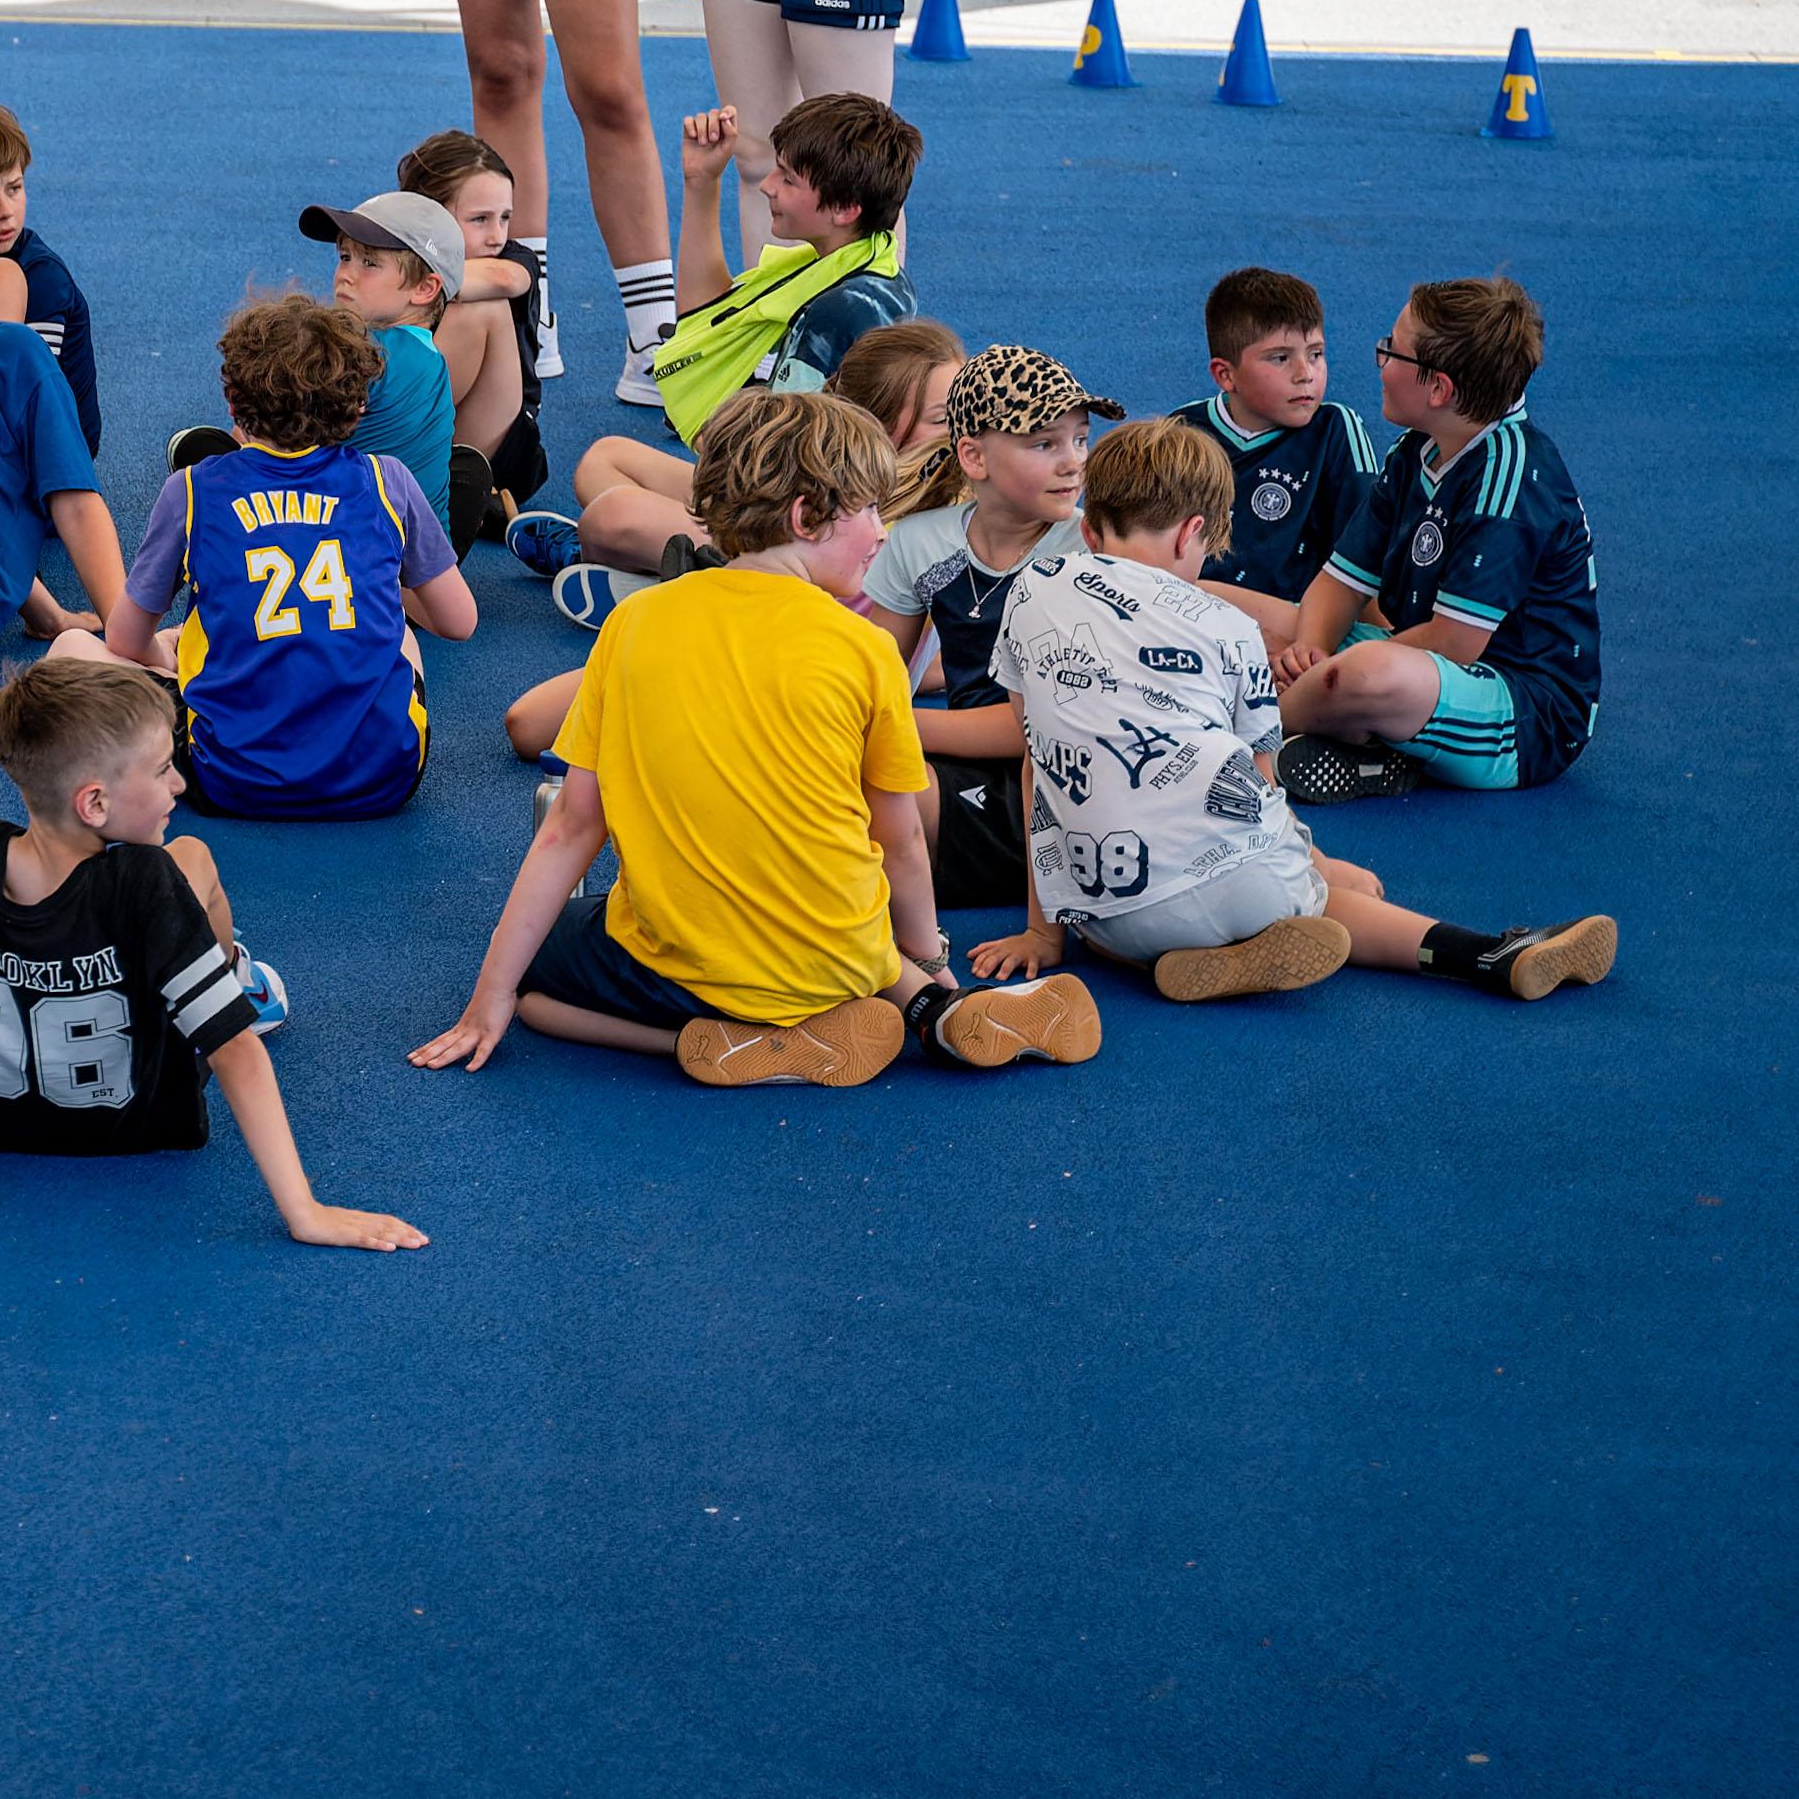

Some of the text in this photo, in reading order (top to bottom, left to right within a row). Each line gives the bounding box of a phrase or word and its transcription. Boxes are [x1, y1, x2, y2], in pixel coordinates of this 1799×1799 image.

[1502, 73, 1538, 122] T
[232, 490, 340, 533] BRYANT
[244, 539, 356, 642] 24
[1074, 571, 1142, 614] Sports
[1065, 830, 1149, 898] 98
